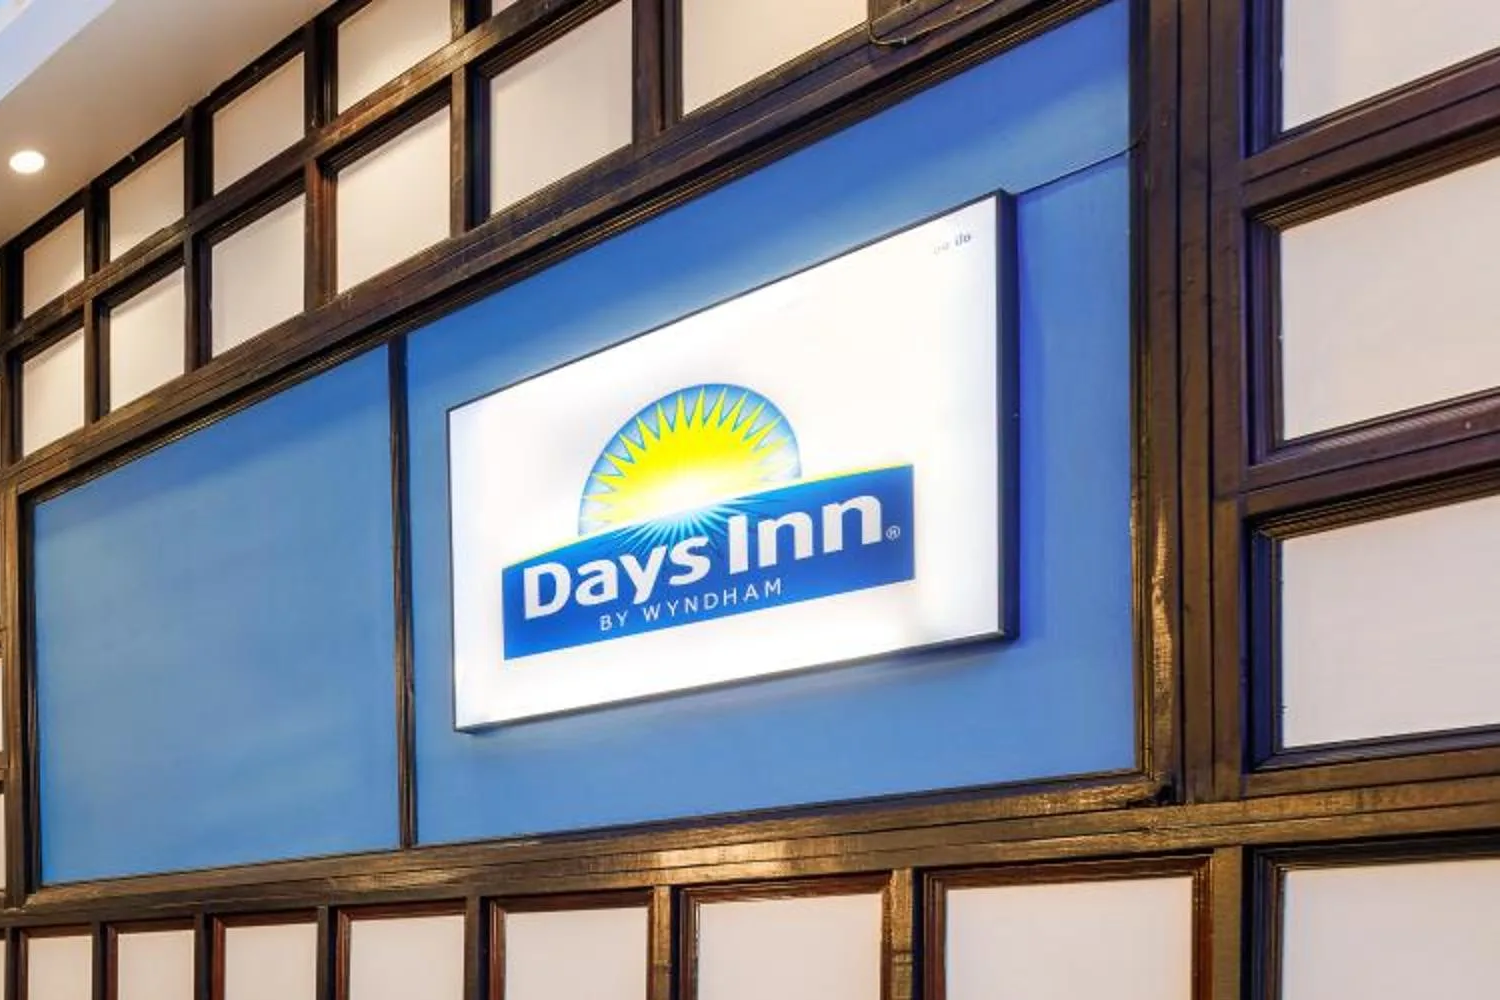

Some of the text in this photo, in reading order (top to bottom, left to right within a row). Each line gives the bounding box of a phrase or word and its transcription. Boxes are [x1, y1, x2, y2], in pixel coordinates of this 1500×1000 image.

[524, 495, 883, 620] Days Inn
[600, 578, 782, 632] BY WYNDHAM
